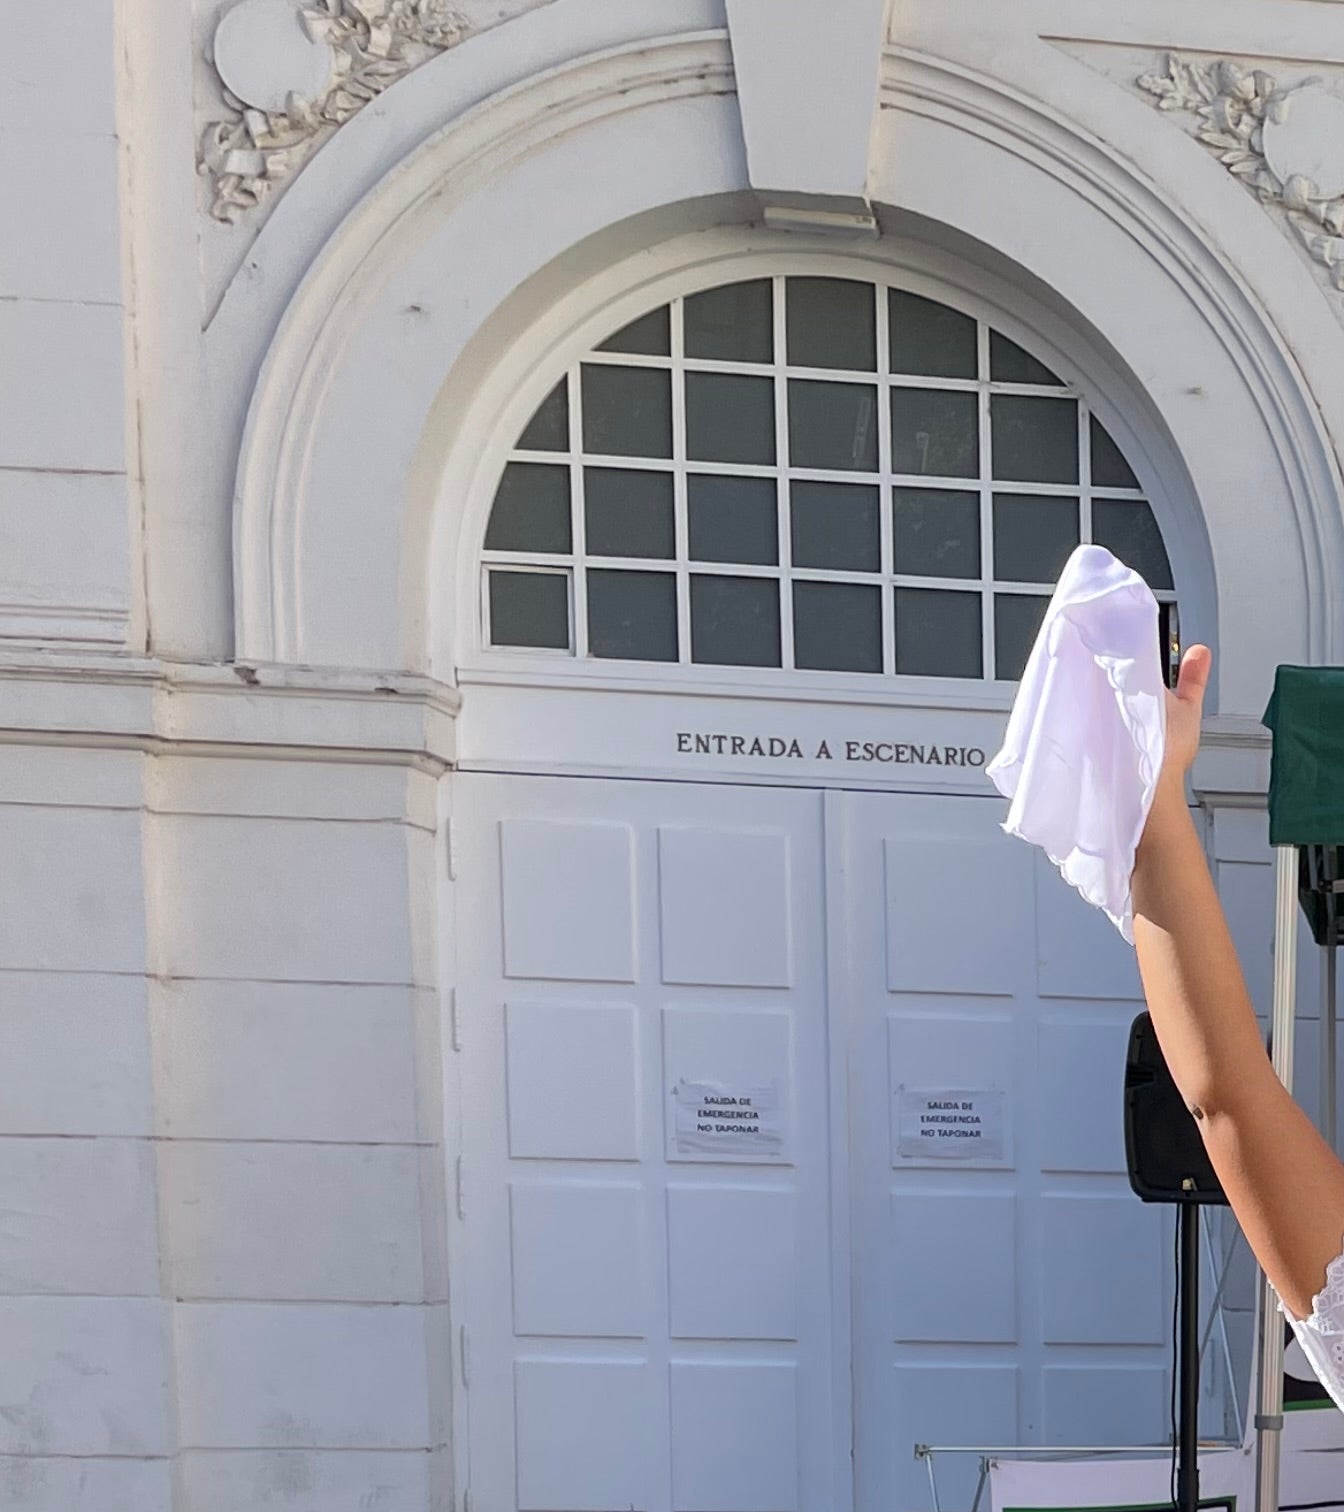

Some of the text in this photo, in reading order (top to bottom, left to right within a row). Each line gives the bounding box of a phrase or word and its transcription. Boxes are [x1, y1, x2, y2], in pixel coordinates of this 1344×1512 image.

[676, 733, 985, 767] ENTRADA A ESCENARIO
[927, 1101, 960, 1110] SALIDA
[697, 1124, 713, 1132] NO
[920, 1129, 936, 1138] NO
